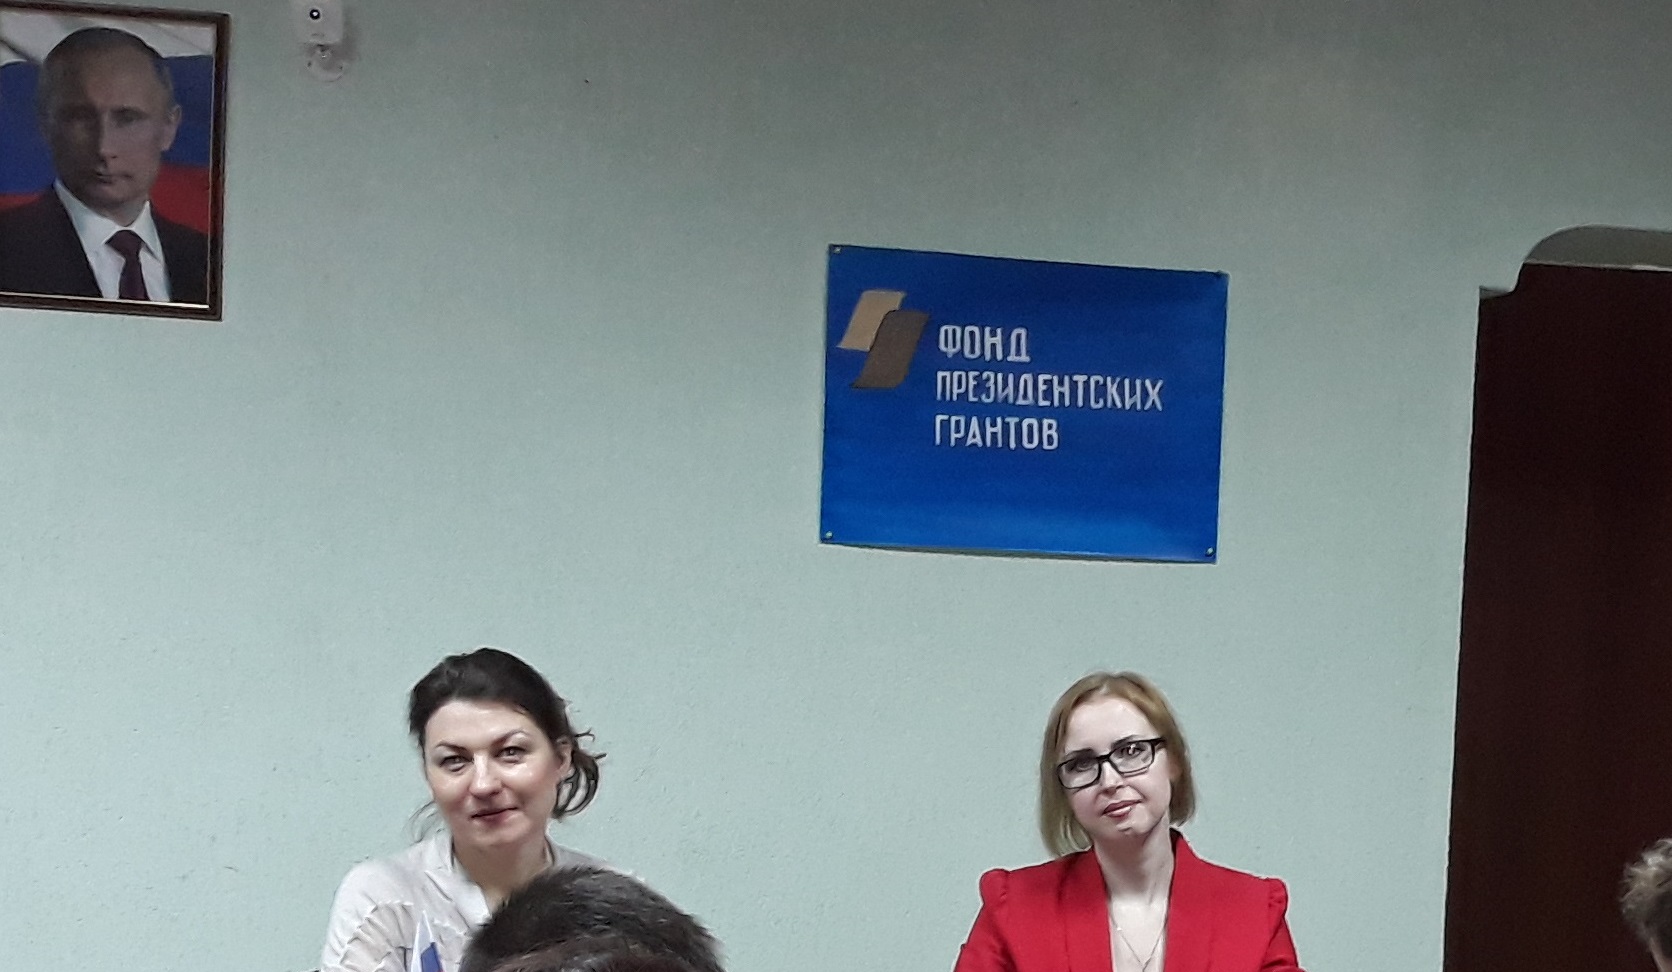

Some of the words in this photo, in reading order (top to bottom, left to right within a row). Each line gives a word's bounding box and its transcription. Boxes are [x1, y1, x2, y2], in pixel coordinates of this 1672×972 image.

[938, 325, 1031, 362] ФОНД
[936, 370, 1163, 411] ПРЕЗИДЕНТСКИХ
[934, 414, 1059, 450] ГРАНТОВ
